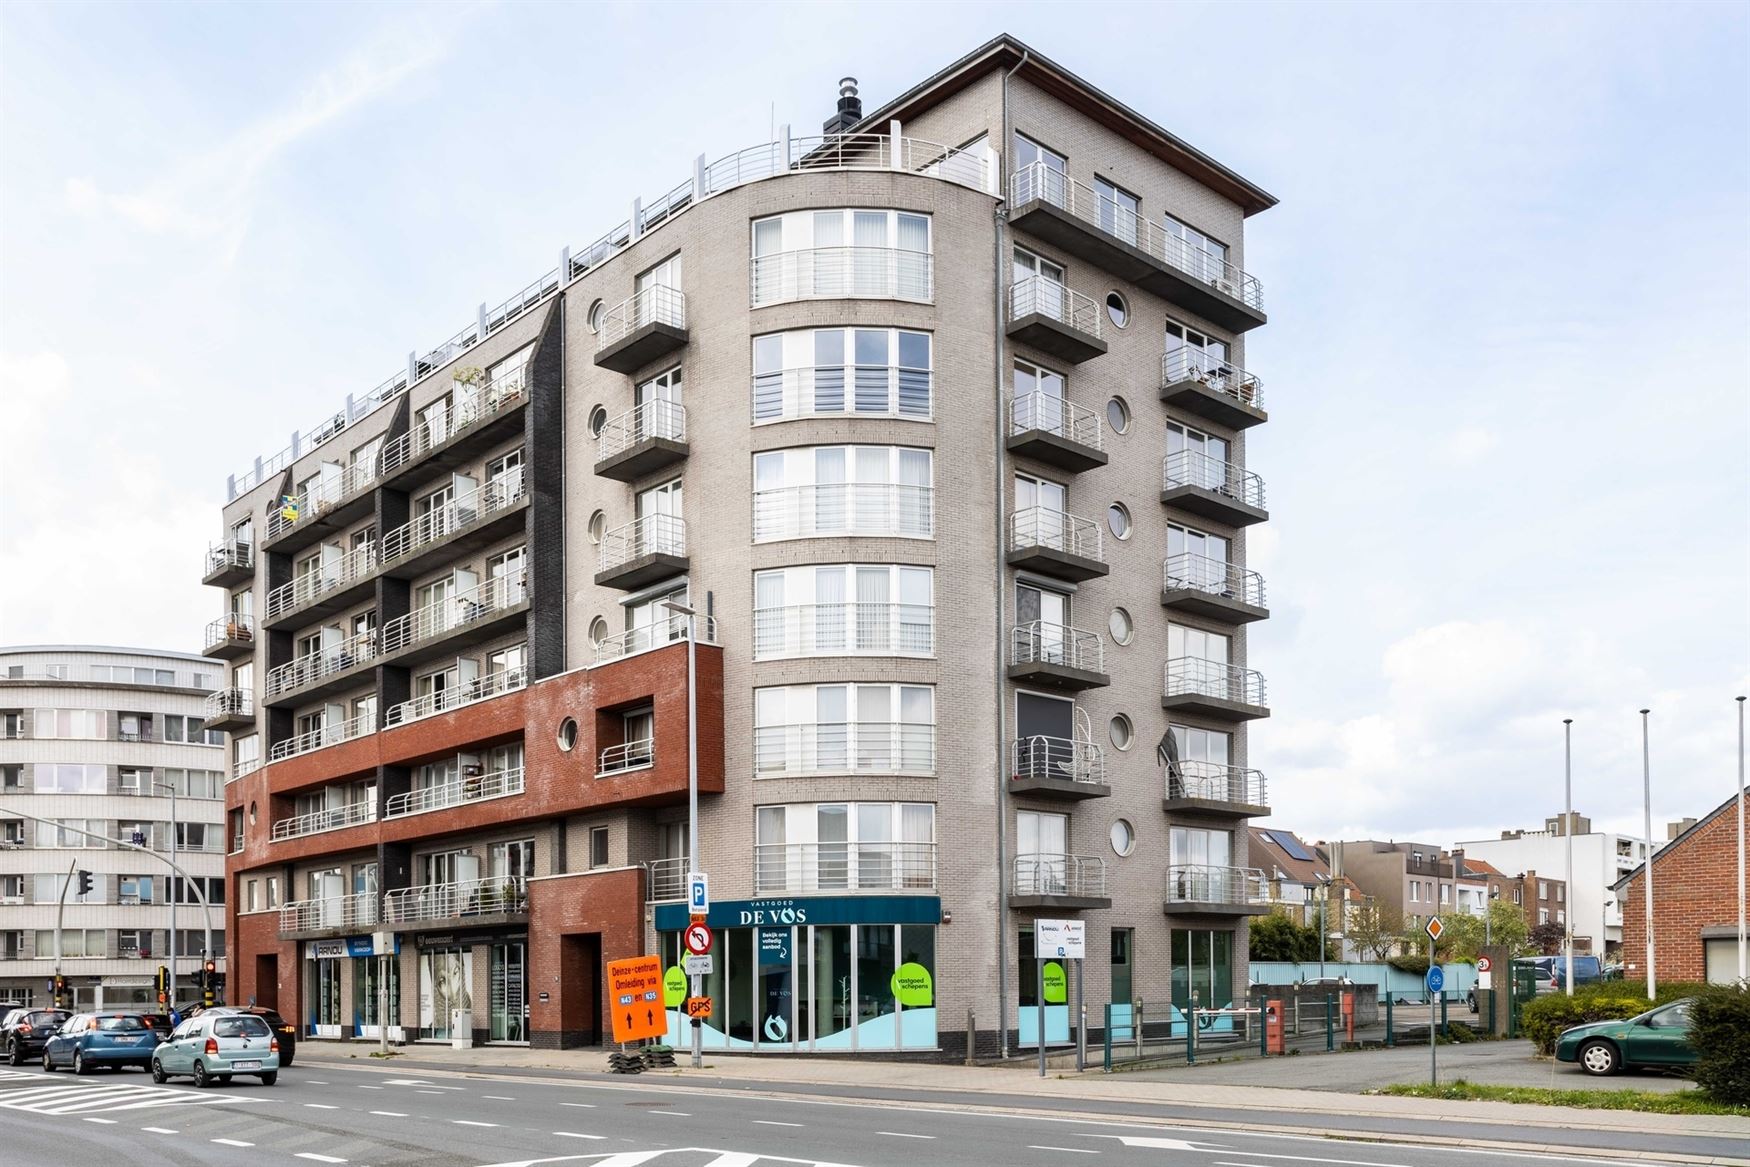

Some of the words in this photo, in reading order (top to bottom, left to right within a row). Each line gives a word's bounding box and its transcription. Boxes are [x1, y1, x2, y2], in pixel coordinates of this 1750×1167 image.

[694, 886, 703, 903] P
[740, 910, 765, 925] DE
[769, 907, 806, 925] VOS
[318, 945, 343, 956] ARNOU
[615, 978, 645, 990] Omleiding
[647, 976, 657, 985] via
[635, 994, 642, 1002] en
[690, 1000, 711, 1013] GPS
